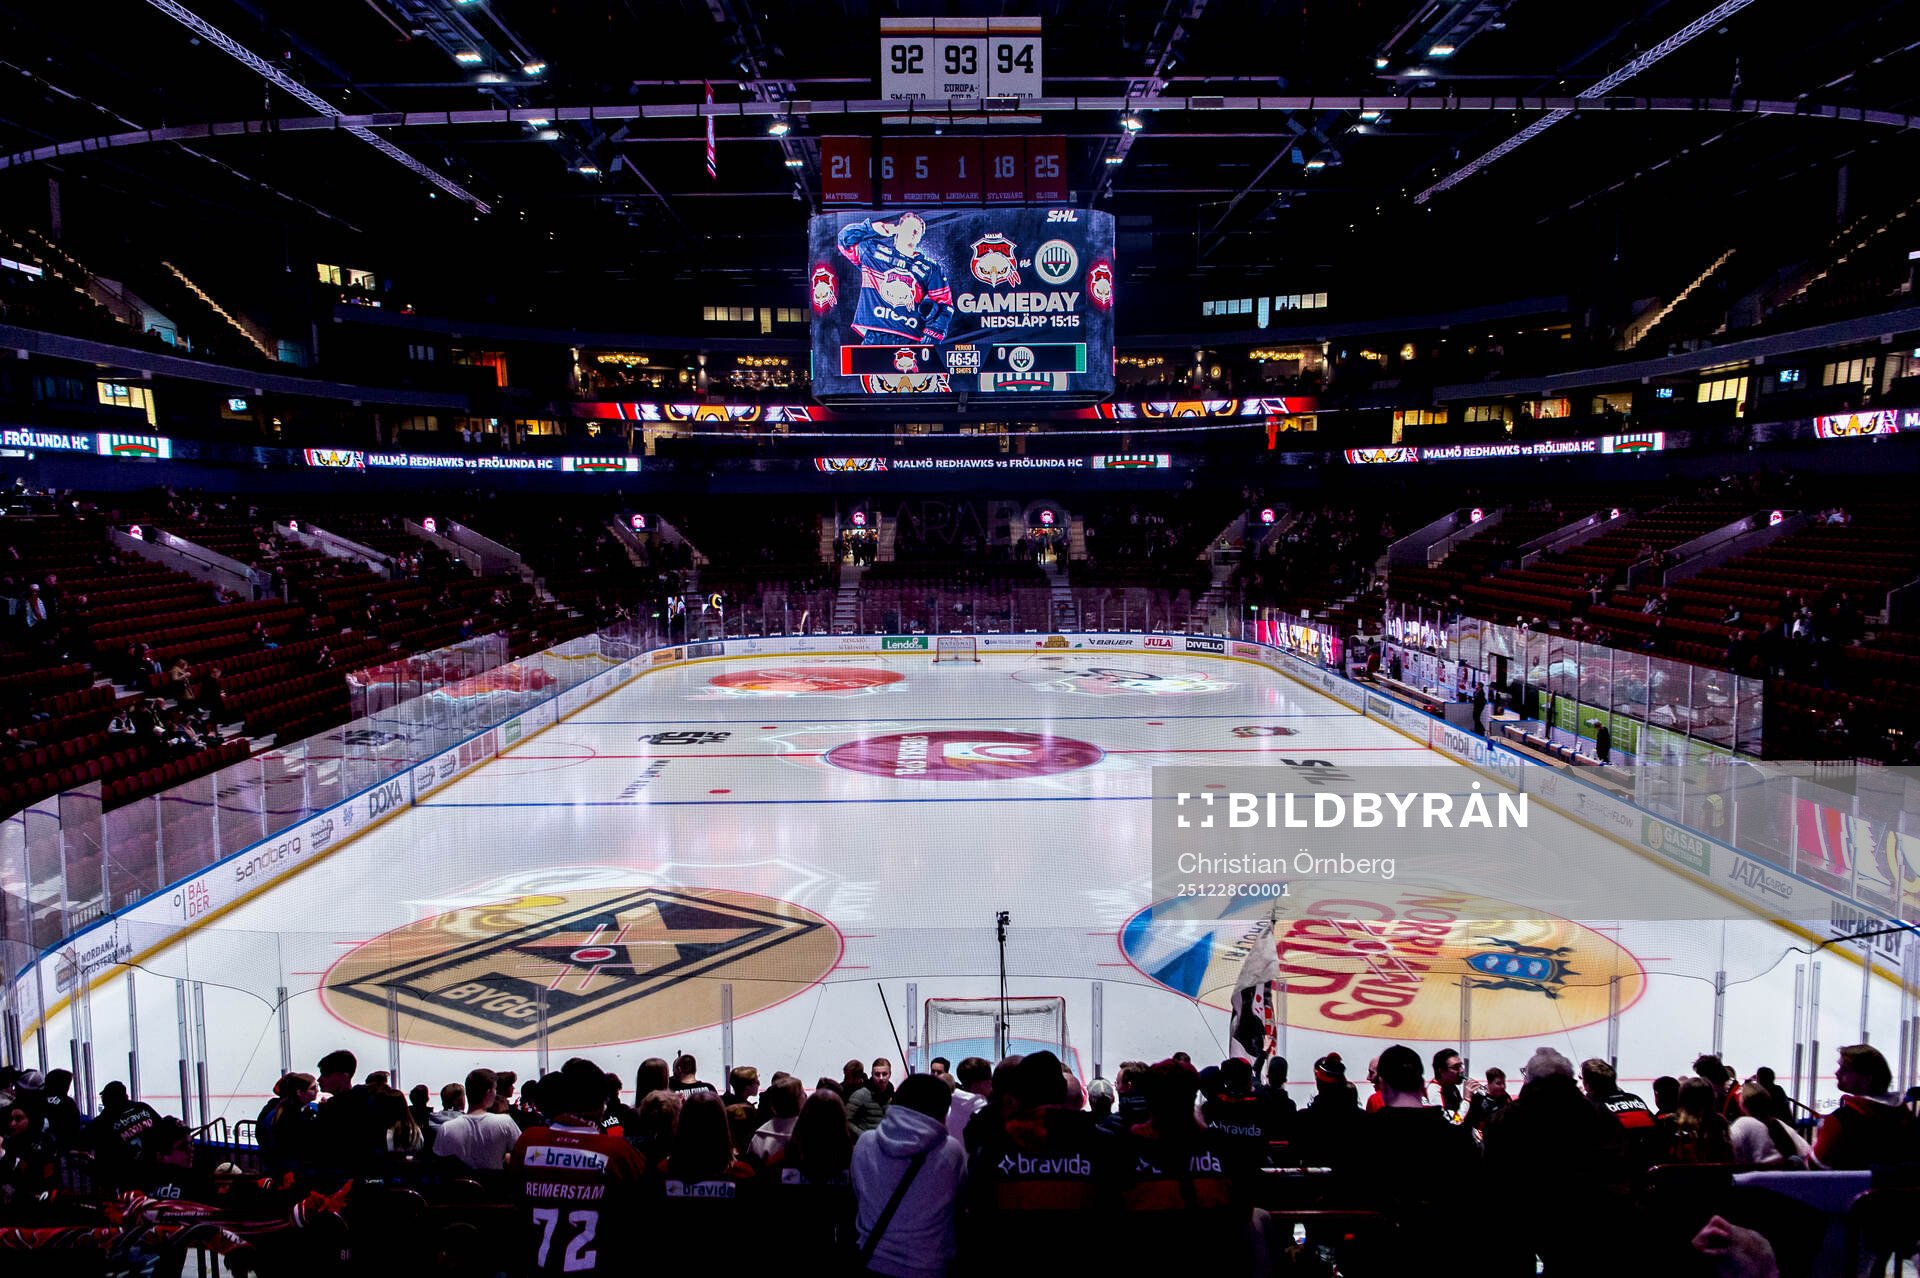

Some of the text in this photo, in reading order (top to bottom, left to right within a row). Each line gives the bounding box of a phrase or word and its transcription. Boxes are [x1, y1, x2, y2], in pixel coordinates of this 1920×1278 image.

[891, 44, 924, 74] 92
[944, 44, 977, 75] 93
[997, 43, 1034, 74] 94
[831, 155, 852, 179] 21
[915, 155, 928, 179] 5
[957, 155, 967, 179] 1
[993, 154, 1015, 179] 18
[1034, 153, 1060, 179] 25
[1047, 209, 1078, 222] SHL
[957, 291, 1080, 313] GAMEDAY
[873, 306, 918, 329] areco
[981, 313, 1080, 328] NEDSLÄPP 15:15
[921, 347, 930, 361] 0
[948, 352, 979, 366] 46:54
[997, 346, 1006, 360] 0
[949, 367, 955, 375] 0
[972, 367, 978, 375] 0
[4, 428, 89, 450] FRÖLUNDA HC
[1423, 440, 1595, 459] MALMÖ REDHAWKS vs FRÖLUNDA HC
[369, 453, 553, 469] MALMÖ REDHAWKS vs FRÖLUNDA HC
[893, 457, 1083, 468] MALMÖ REDHAWKS vs FRÖLUNDA HC
[1144, 637, 1172, 648] JULA
[1186, 640, 1224, 651] DIVELLO
[369, 779, 404, 819] DOXA
[1663, 825, 1703, 857] GASAB
[1728, 856, 1794, 897] JATA CARGO
[188, 879, 209, 901] BAL
[189, 895, 210, 918] DER
[81, 934, 115, 964] NORDANÅ
[439, 982, 551, 1019] BYGG
[1606, 1098, 1647, 1114] bravida
[601, 1115, 620, 1128] vida
[1218, 1122, 1262, 1137] bravida
[545, 1147, 605, 1169] bravida
[1017, 1153, 1092, 1175] bravida
[525, 1181, 605, 1200] REIMERSTAM
[532, 1207, 600, 1272] 72
